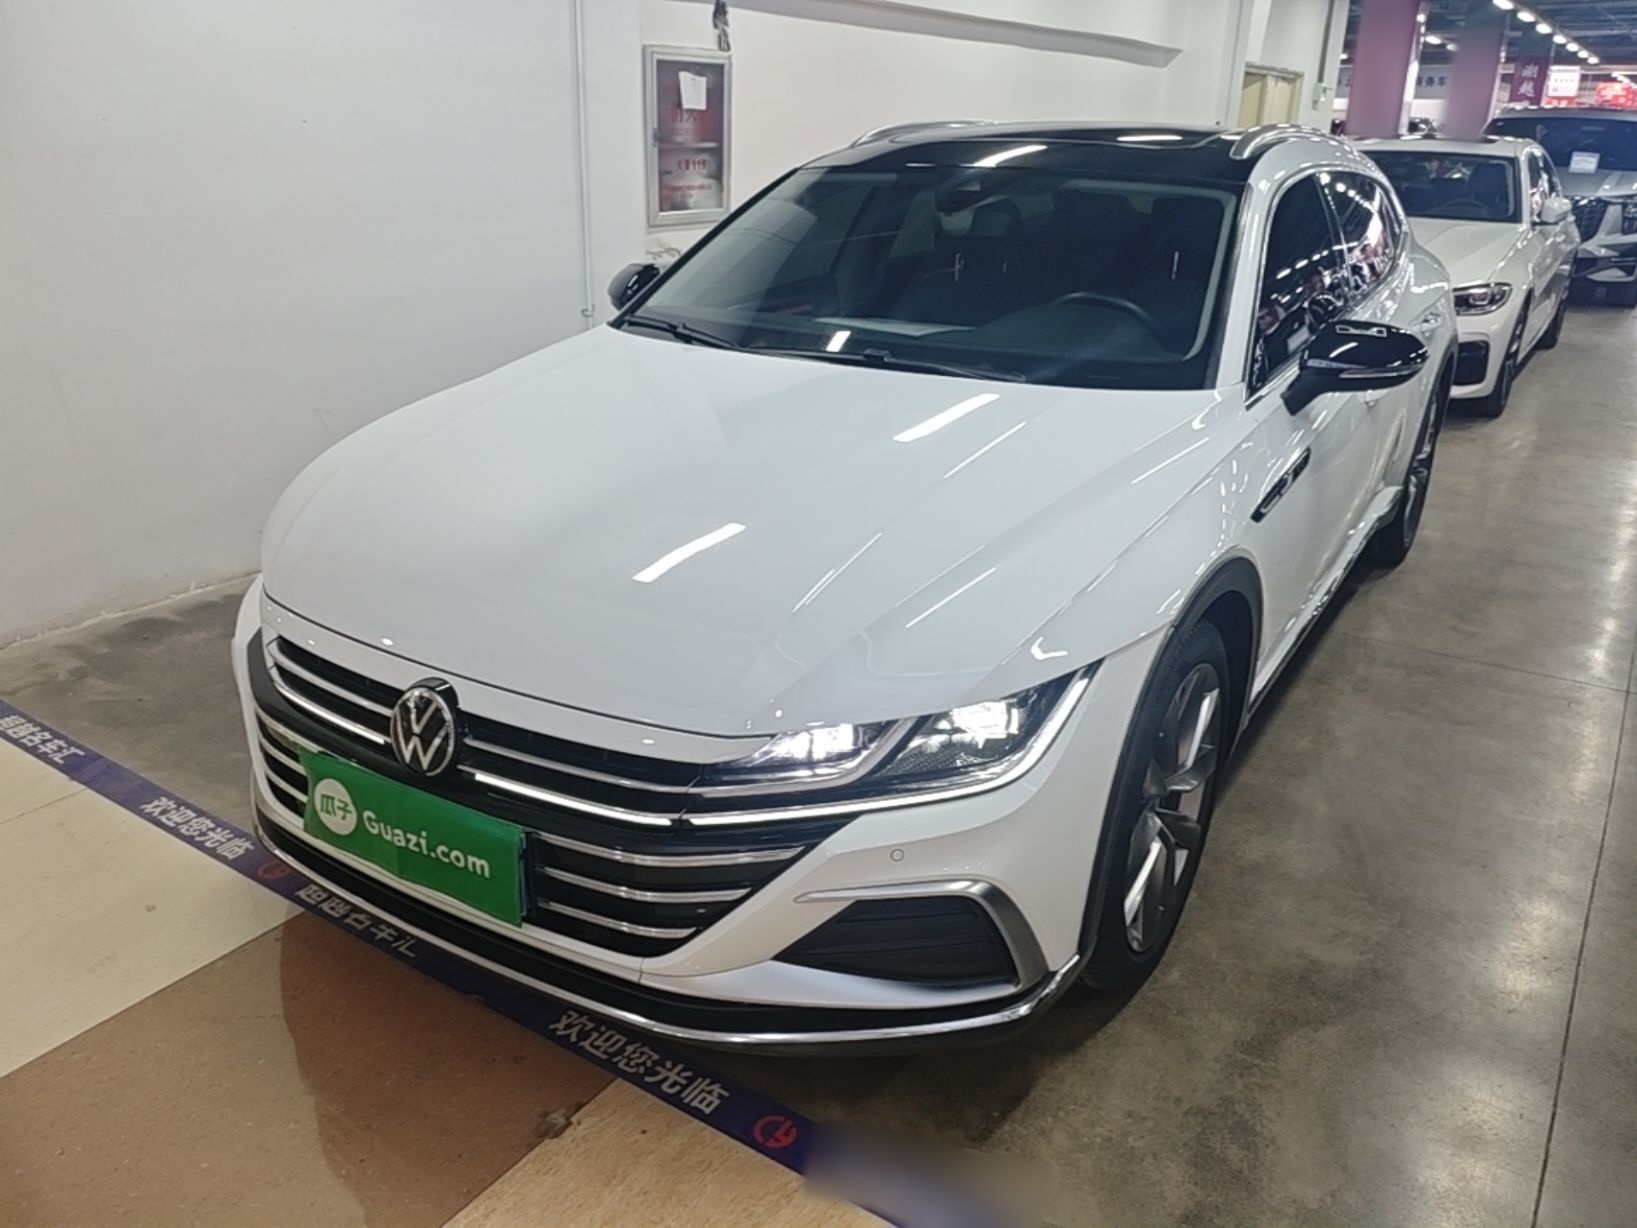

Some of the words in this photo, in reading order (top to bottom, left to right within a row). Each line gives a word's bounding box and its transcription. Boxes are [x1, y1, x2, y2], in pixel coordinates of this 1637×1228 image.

[140, 797, 255, 860] 欢迎您光临
[320, 794, 353, 820] 瓜子
[362, 810, 490, 879] Guazi.com
[548, 1008, 730, 1115] 欢迎您光临
